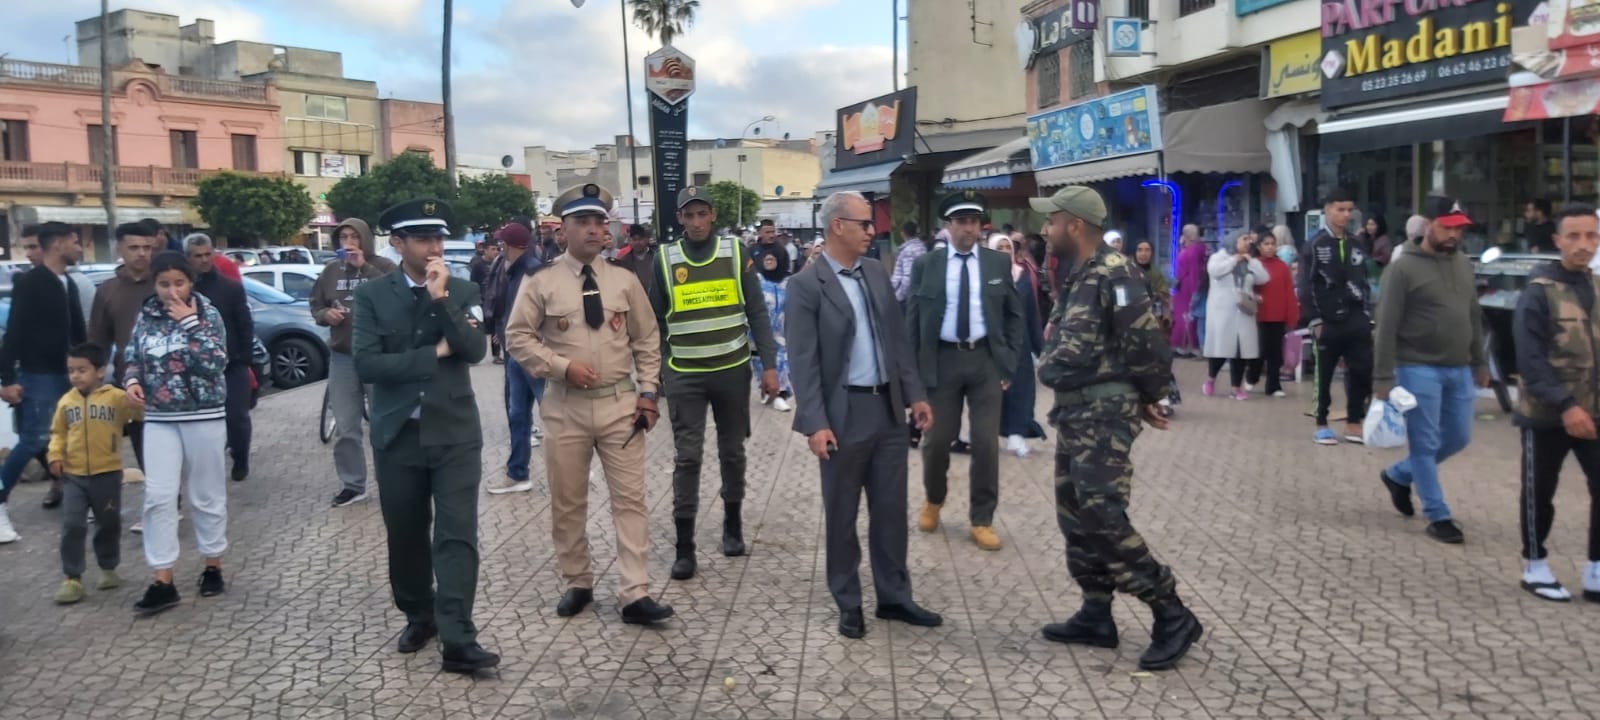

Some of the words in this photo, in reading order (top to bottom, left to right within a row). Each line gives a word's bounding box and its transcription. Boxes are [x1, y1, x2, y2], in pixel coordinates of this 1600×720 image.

[1321, 0, 1478, 38] PARF
[1345, 3, 1513, 77] Madani
[1361, 80, 1373, 91] 05
[1374, 78, 1386, 89] 23
[1387, 76, 1399, 87] 35
[1400, 73, 1412, 84] 26
[1414, 70, 1427, 82] 69
[1437, 66, 1450, 77] 06
[1453, 63, 1466, 75] 62
[1468, 60, 1481, 71] 46
[1482, 57, 1496, 70] 23
